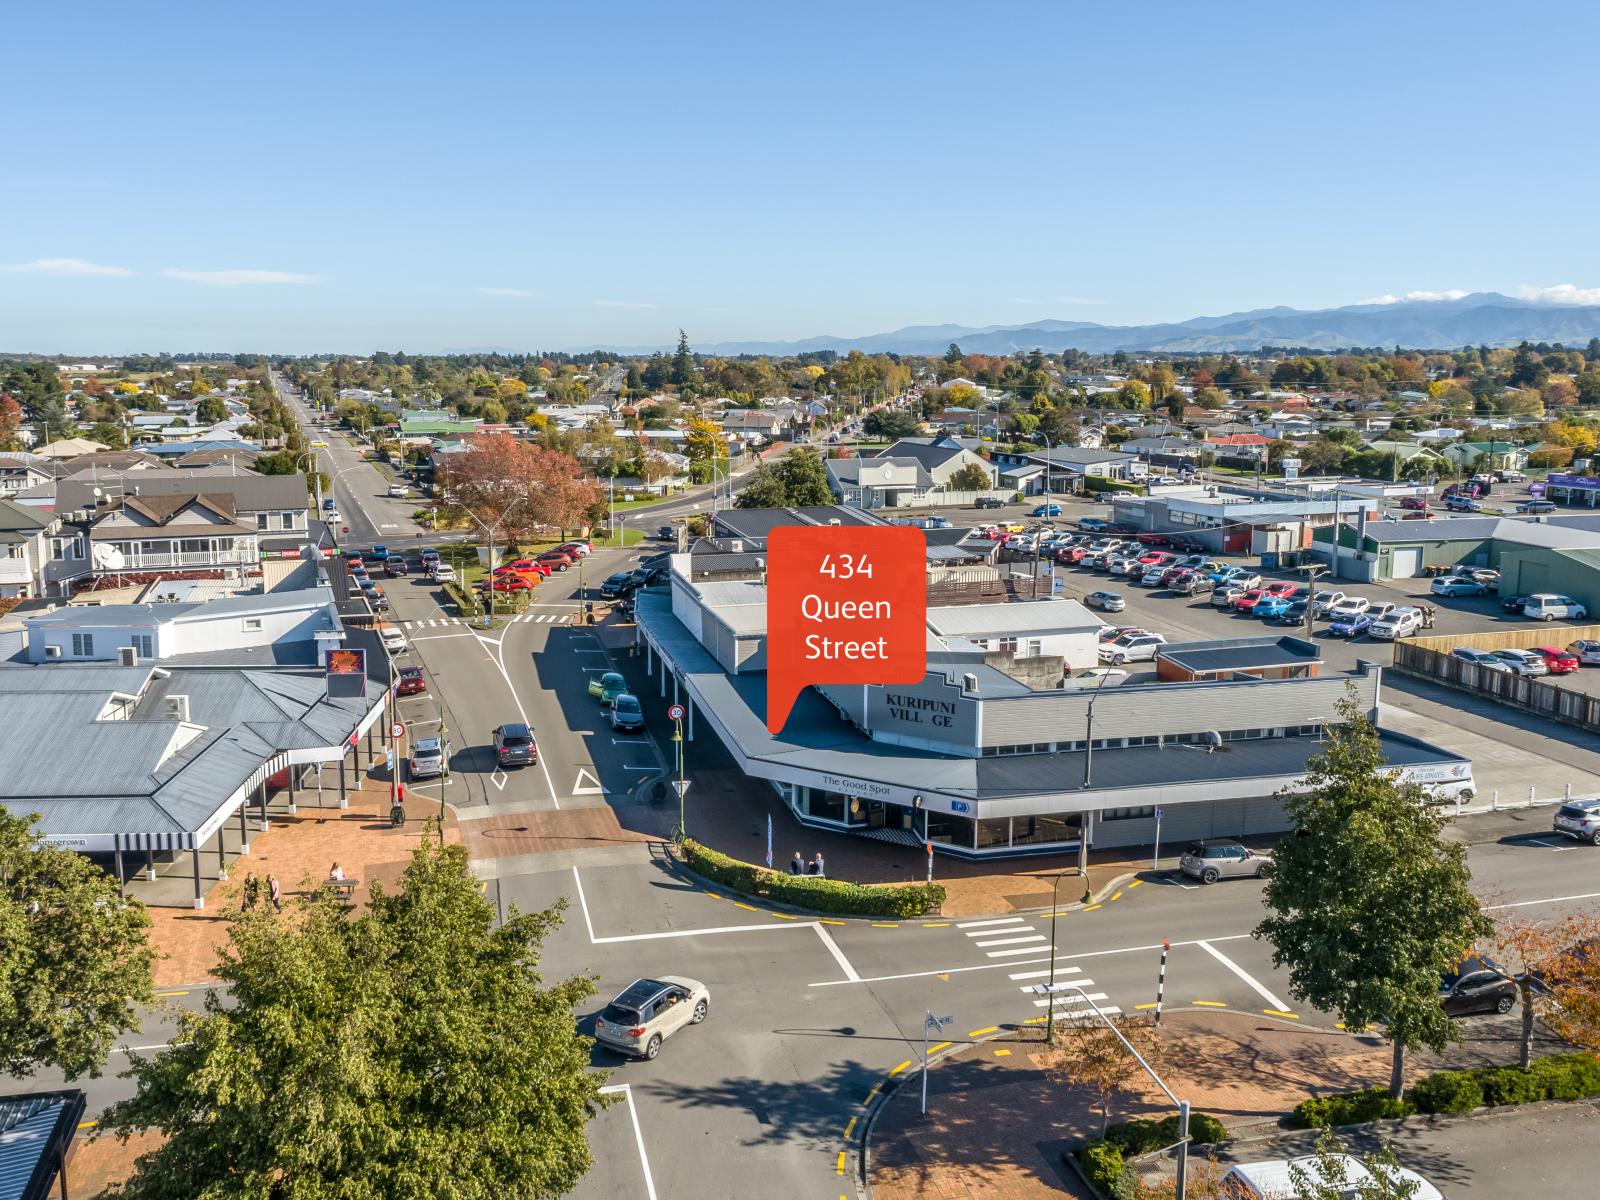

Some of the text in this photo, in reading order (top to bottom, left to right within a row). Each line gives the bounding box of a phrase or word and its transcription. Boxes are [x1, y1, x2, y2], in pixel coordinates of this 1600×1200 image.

[672, 709, 682, 717] 30
[886, 693, 956, 714] KURIPUNI
[822, 775, 891, 796] The Good Spot
